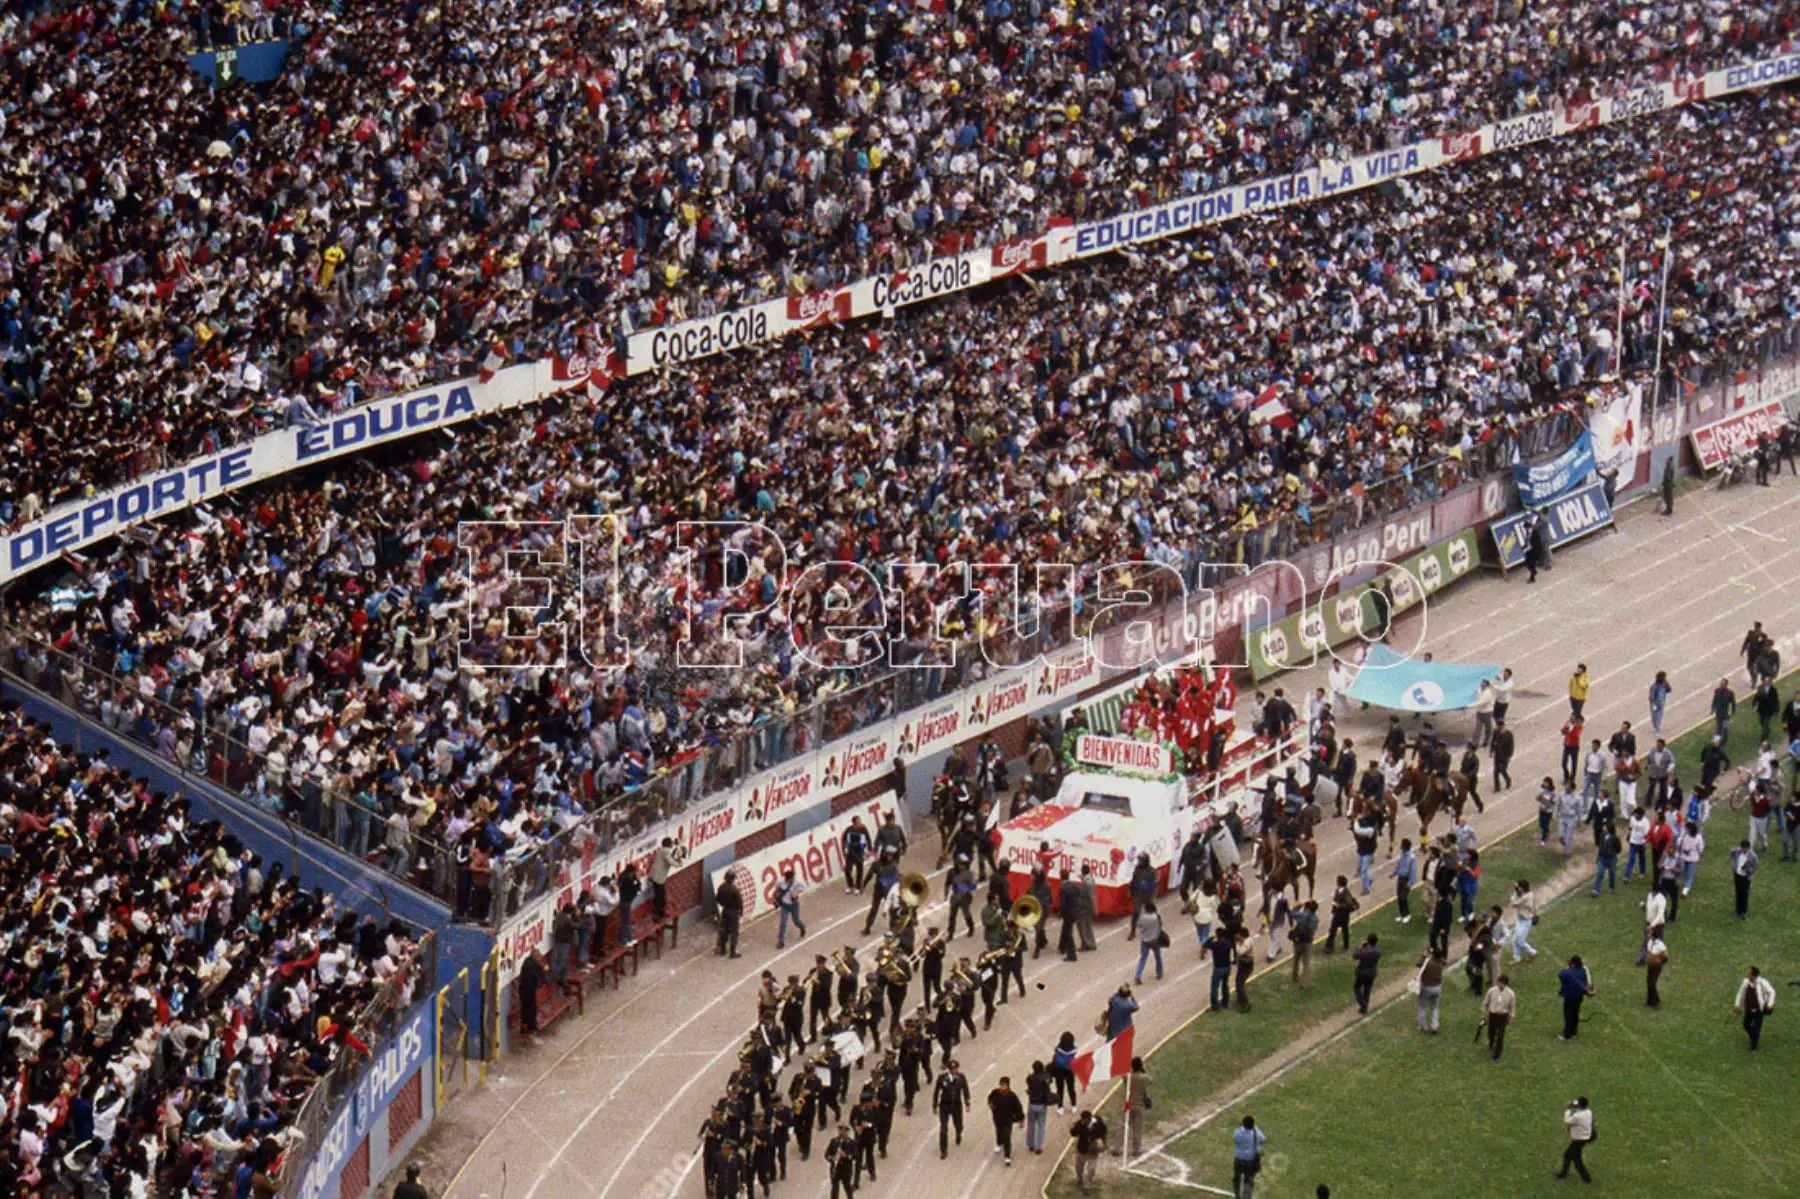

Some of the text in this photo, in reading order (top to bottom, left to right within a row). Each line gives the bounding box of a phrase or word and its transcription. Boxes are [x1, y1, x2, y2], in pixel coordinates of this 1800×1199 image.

[1076, 191, 1233, 252] EDUCACION
[1244, 175, 1311, 209] PARA
[1321, 166, 1354, 192] LA
[652, 308, 766, 365] Coca-Cola
[10, 385, 476, 570] DEPORTE EDUCA
[1556, 493, 1599, 535] KOLA
[1082, 735, 1161, 770] BIENVENIDAS
[1060, 854, 1075, 874] DE
[370, 1016, 422, 1112] PHILIPS
